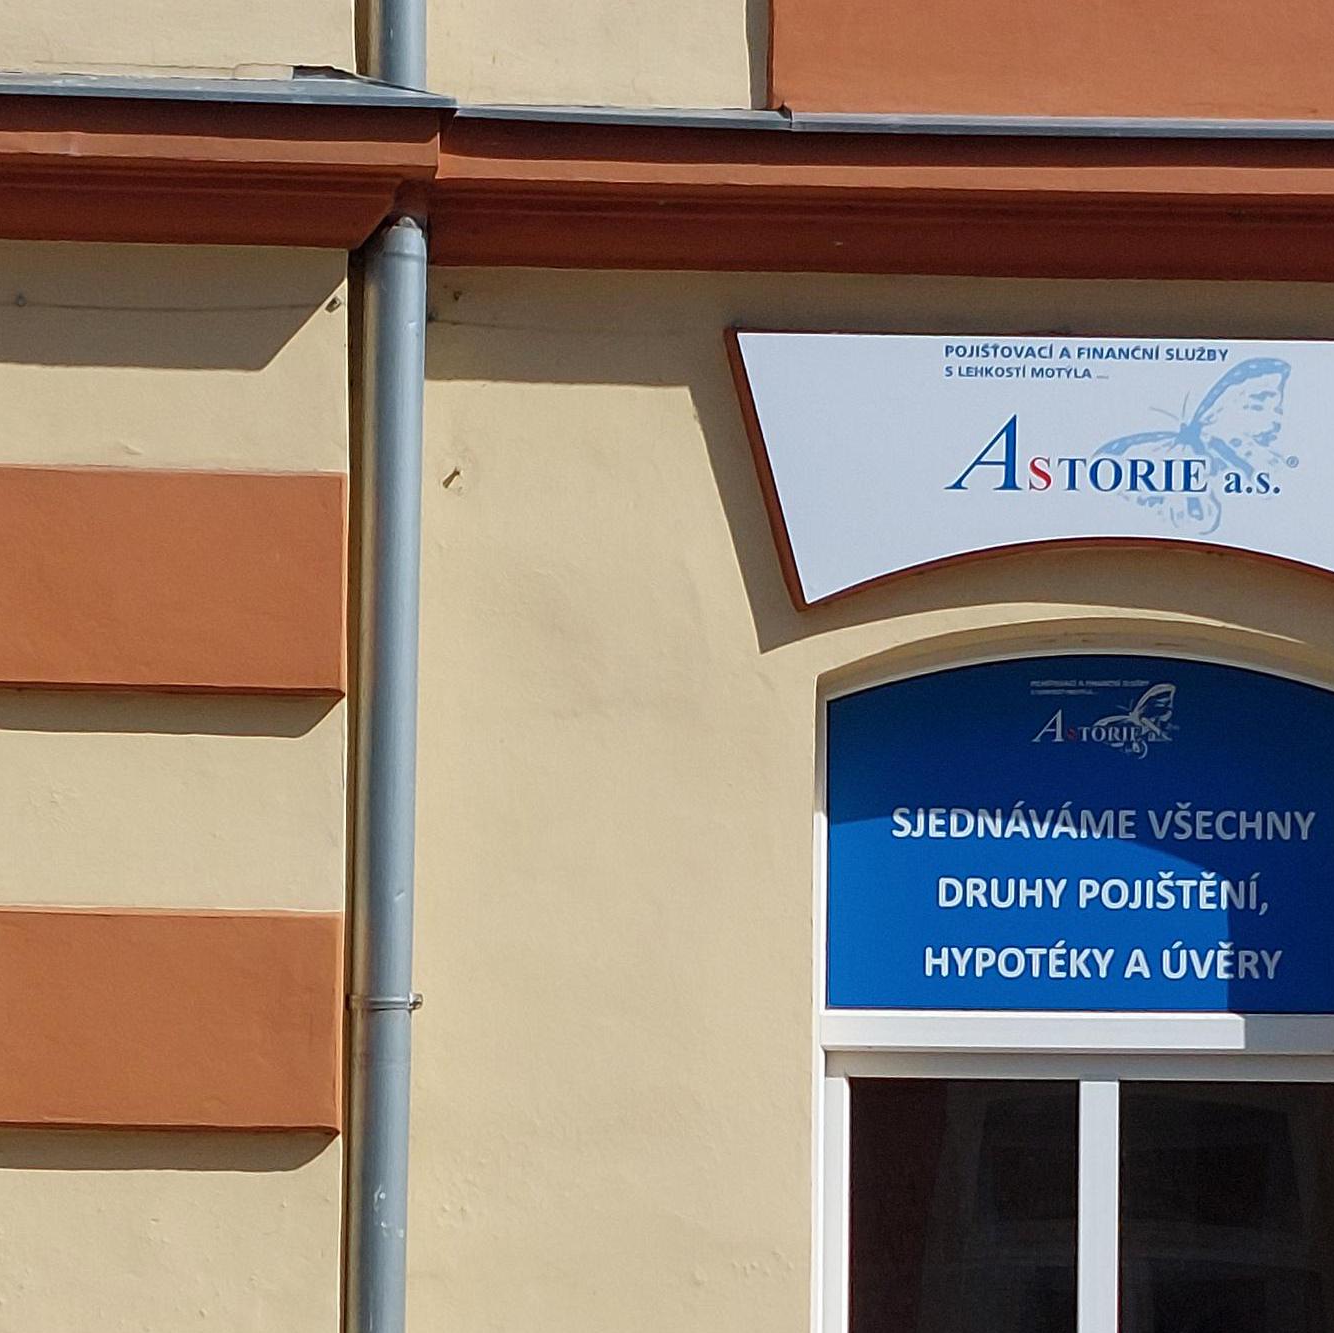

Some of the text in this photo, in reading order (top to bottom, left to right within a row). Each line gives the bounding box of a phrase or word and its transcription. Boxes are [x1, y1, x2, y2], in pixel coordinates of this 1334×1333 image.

[944, 343, 1229, 362] POJIŠŤOVACÍ A FINANČNÍ SLUŽBY
[945, 366, 954, 378] S
[958, 364, 1026, 378] LEHKOSTÍ
[1030, 365, 1092, 379] MOTÝLA
[1224, 471, 1281, 494] a.s.
[892, 801, 1315, 840] SJEDNÁVÁME VŠECHNY
[938, 872, 1269, 915] DRUHY POJIŠTĚNÍ,
[925, 940, 1282, 980] HYPOTÉKY A ÚVĚRY
